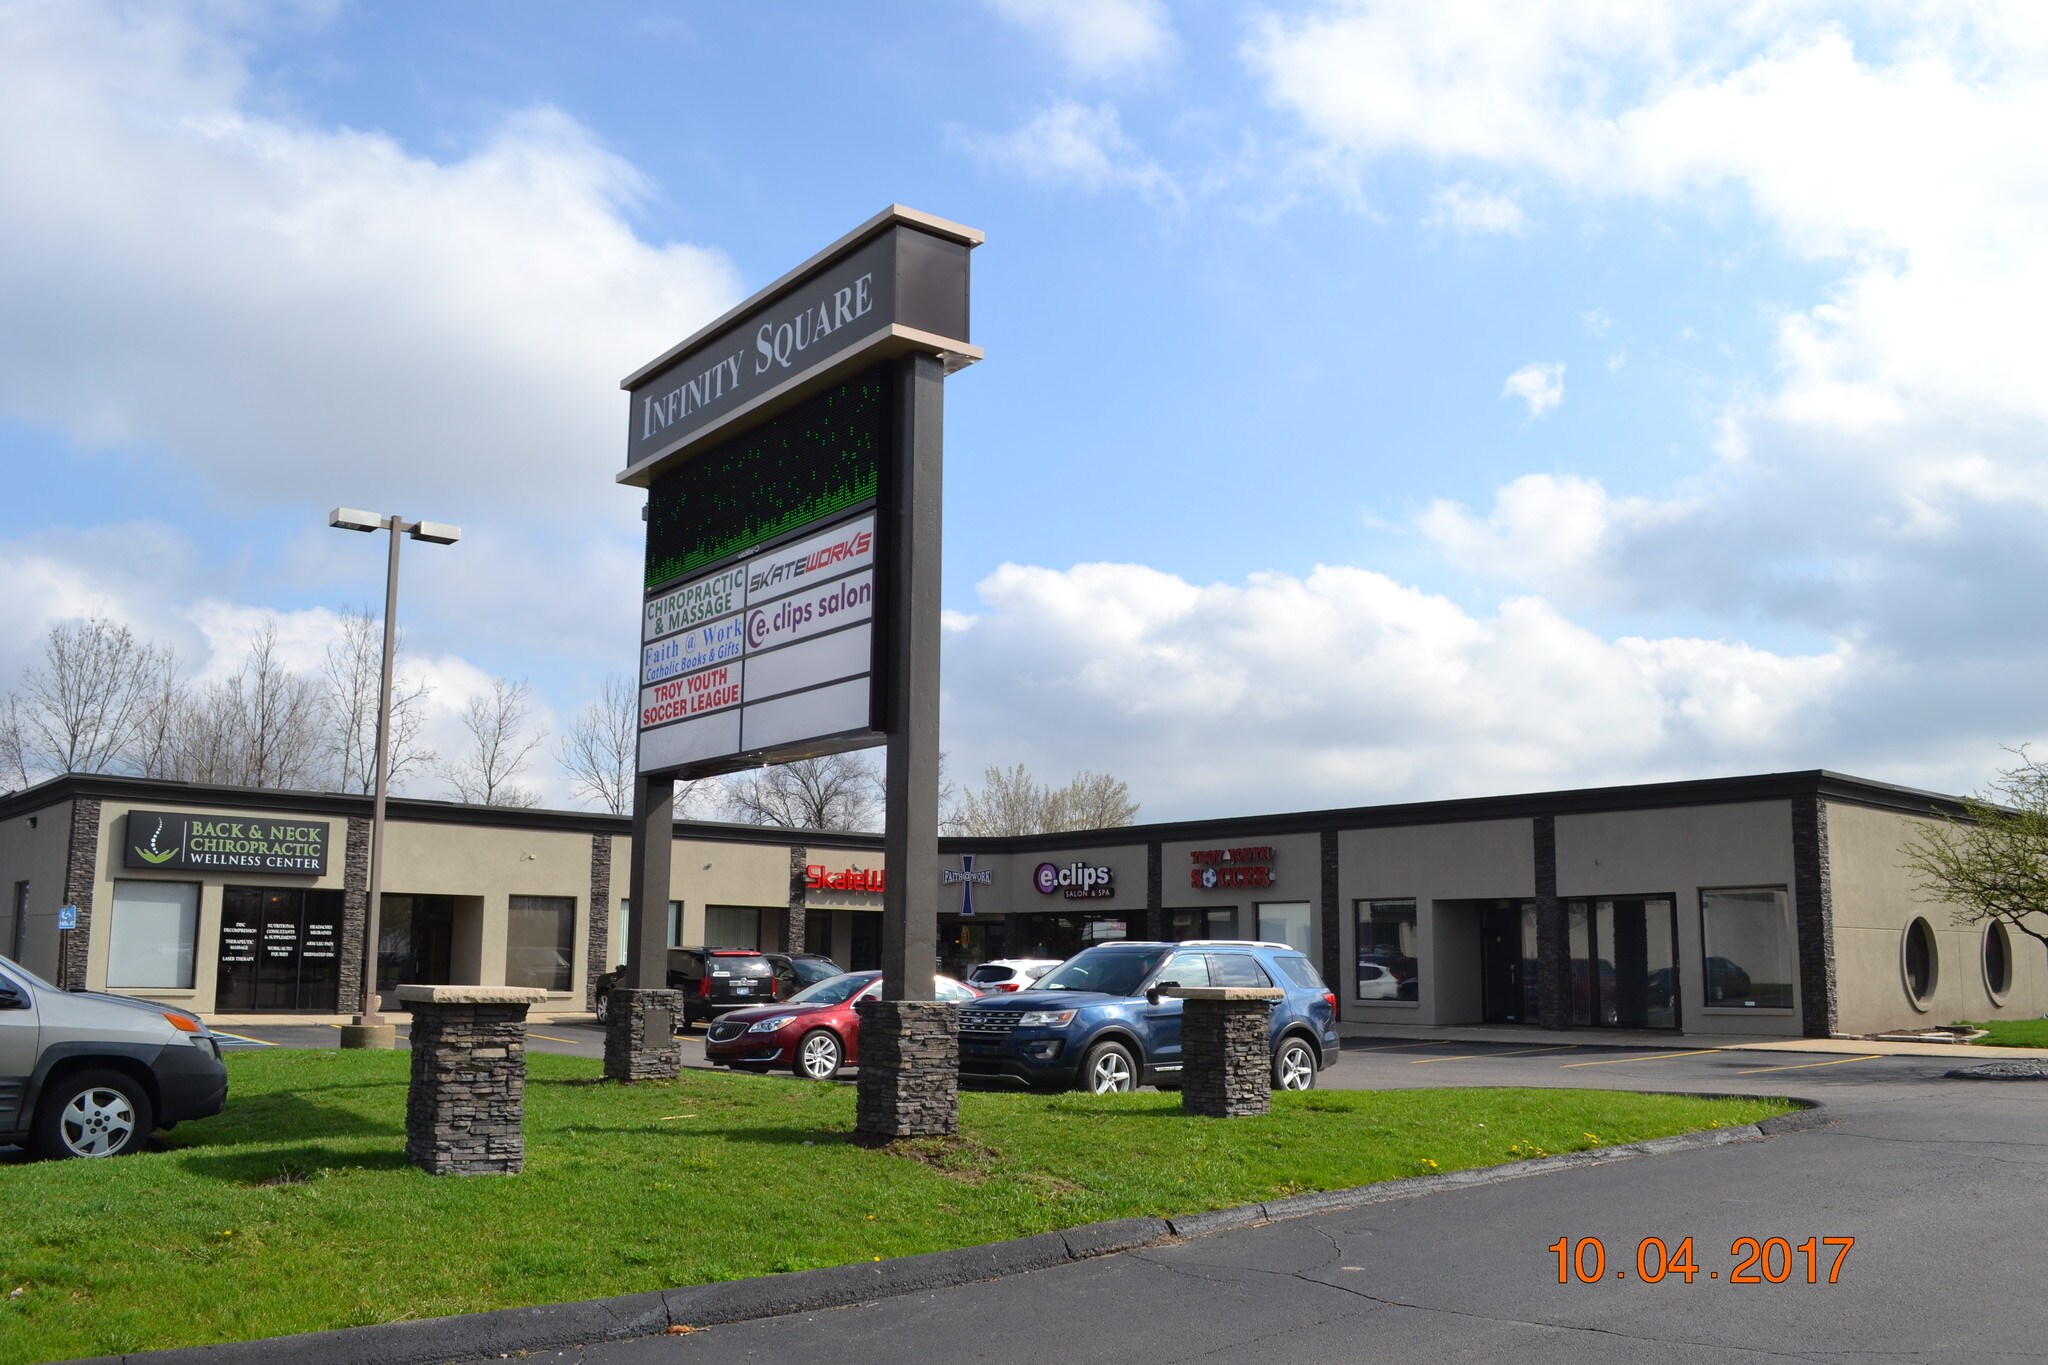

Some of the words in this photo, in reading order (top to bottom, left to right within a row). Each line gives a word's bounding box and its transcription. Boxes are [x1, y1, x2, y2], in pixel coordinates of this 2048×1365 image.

[642, 349, 744, 441] INFINITY
[755, 273, 873, 376] SQUARE
[749, 532, 873, 593] SKATEWORKS
[647, 570, 743, 620] CHIROPRACTIC
[818, 582, 871, 617] salon
[655, 617, 664, 635] &
[669, 592, 732, 631] MASSAGE
[645, 639, 679, 666] Faith
[685, 631, 696, 653] @
[703, 618, 742, 646] Work
[646, 660, 679, 682] Catholic
[681, 652, 706, 671] Books
[709, 648, 715, 661] &
[718, 641, 739, 659] Gifts
[654, 680, 684, 703] TROY
[687, 668, 727, 694] YOUTH
[643, 698, 687, 725] SOCCER
[691, 684, 739, 713] LEAGUE
[190, 838, 321, 857] CHIROPRACTIC
[191, 821, 245, 838] BACK
[248, 824, 263, 839] &
[269, 825, 322, 843] NECK
[190, 853, 261, 867] WELLNESS
[266, 857, 321, 869] CENTER
[1190, 849, 1223, 864] TROY
[1227, 846, 1273, 862] YOUTH
[806, 864, 885, 893] SkateW
[1065, 890, 1088, 898] SALON
